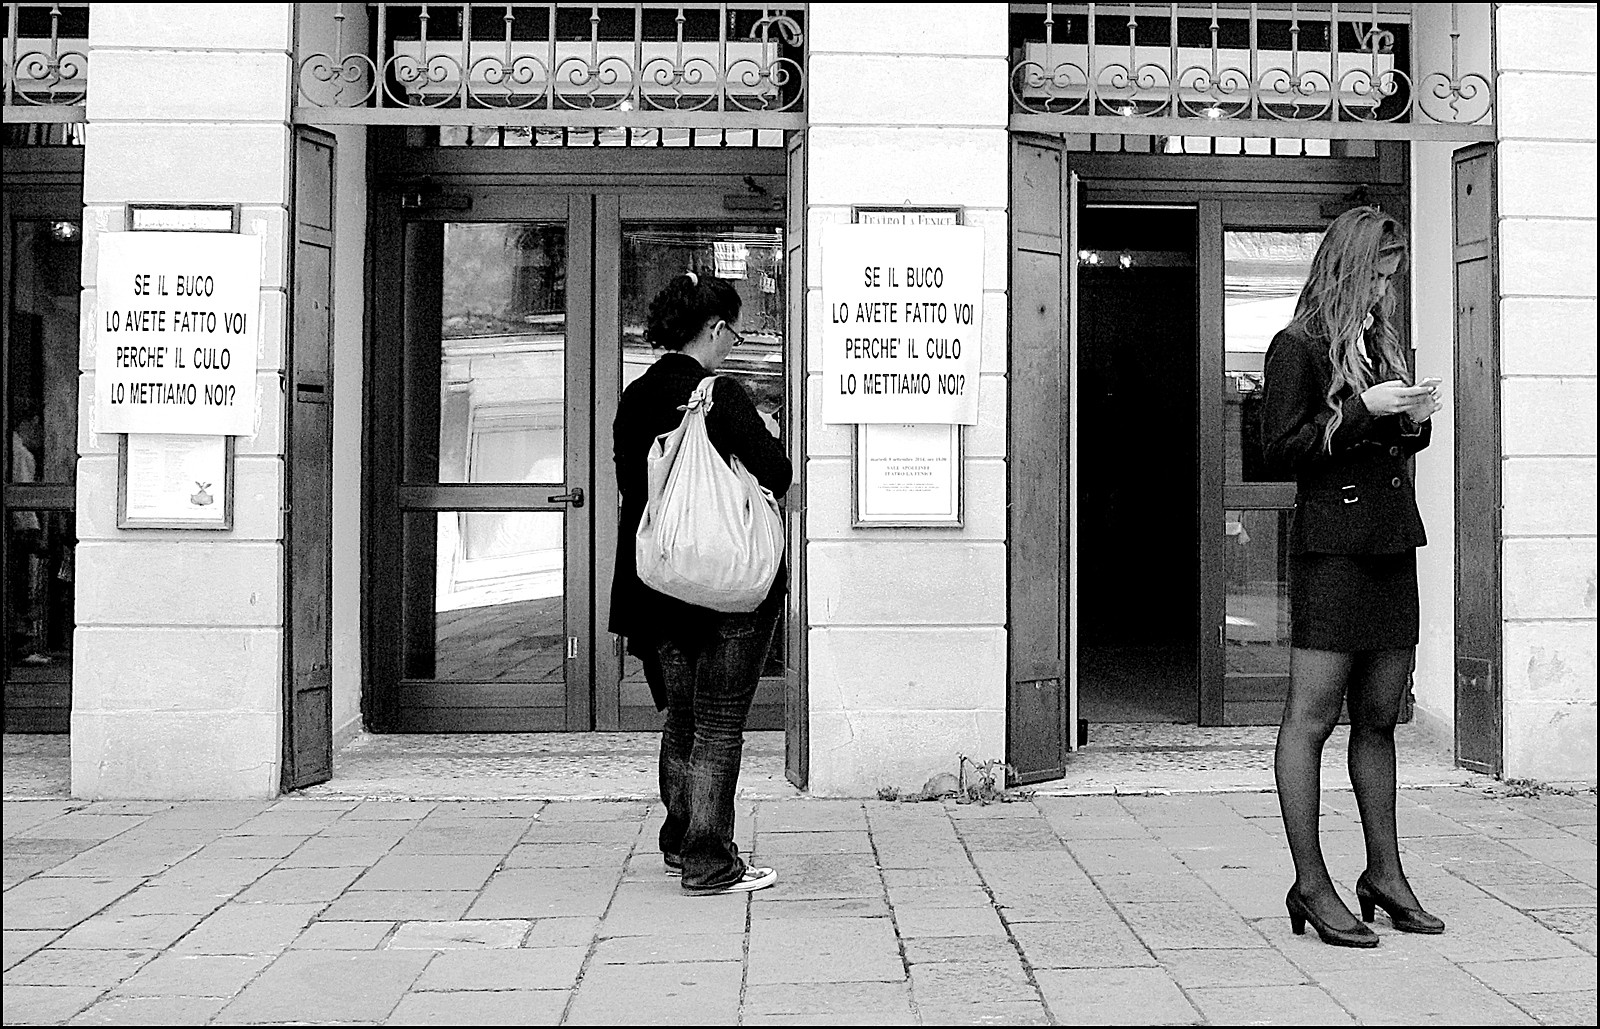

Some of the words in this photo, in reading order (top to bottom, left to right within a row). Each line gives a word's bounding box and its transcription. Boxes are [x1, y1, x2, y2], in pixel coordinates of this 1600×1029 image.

[134, 274, 151, 296] SE
[158, 275, 169, 296] IL
[176, 275, 214, 298] BUCO
[865, 267, 881, 288] SE
[888, 267, 899, 288] IL
[906, 267, 944, 289] BUCO
[106, 310, 120, 333] LO
[125, 310, 166, 332] AVETE
[173, 310, 217, 334] FATTO
[224, 312, 247, 335] VOI
[832, 302, 849, 324] LO
[855, 302, 898, 323] AVETE
[905, 302, 947, 324] FATTO
[954, 303, 974, 326] VOI
[116, 346, 168, 368] PERCHE'
[175, 347, 186, 369] IL
[193, 347, 231, 370] CULO
[845, 337, 901, 359] PERCHE'
[908, 338, 919, 359] IL
[926, 337, 961, 360] CULO
[111, 382, 125, 405] LO
[130, 382, 197, 406] METTIAMO
[204, 384, 236, 407] NOI?
[840, 373, 857, 395] LO
[863, 372, 931, 395] METTIAMO
[938, 373, 966, 396] NOI?
